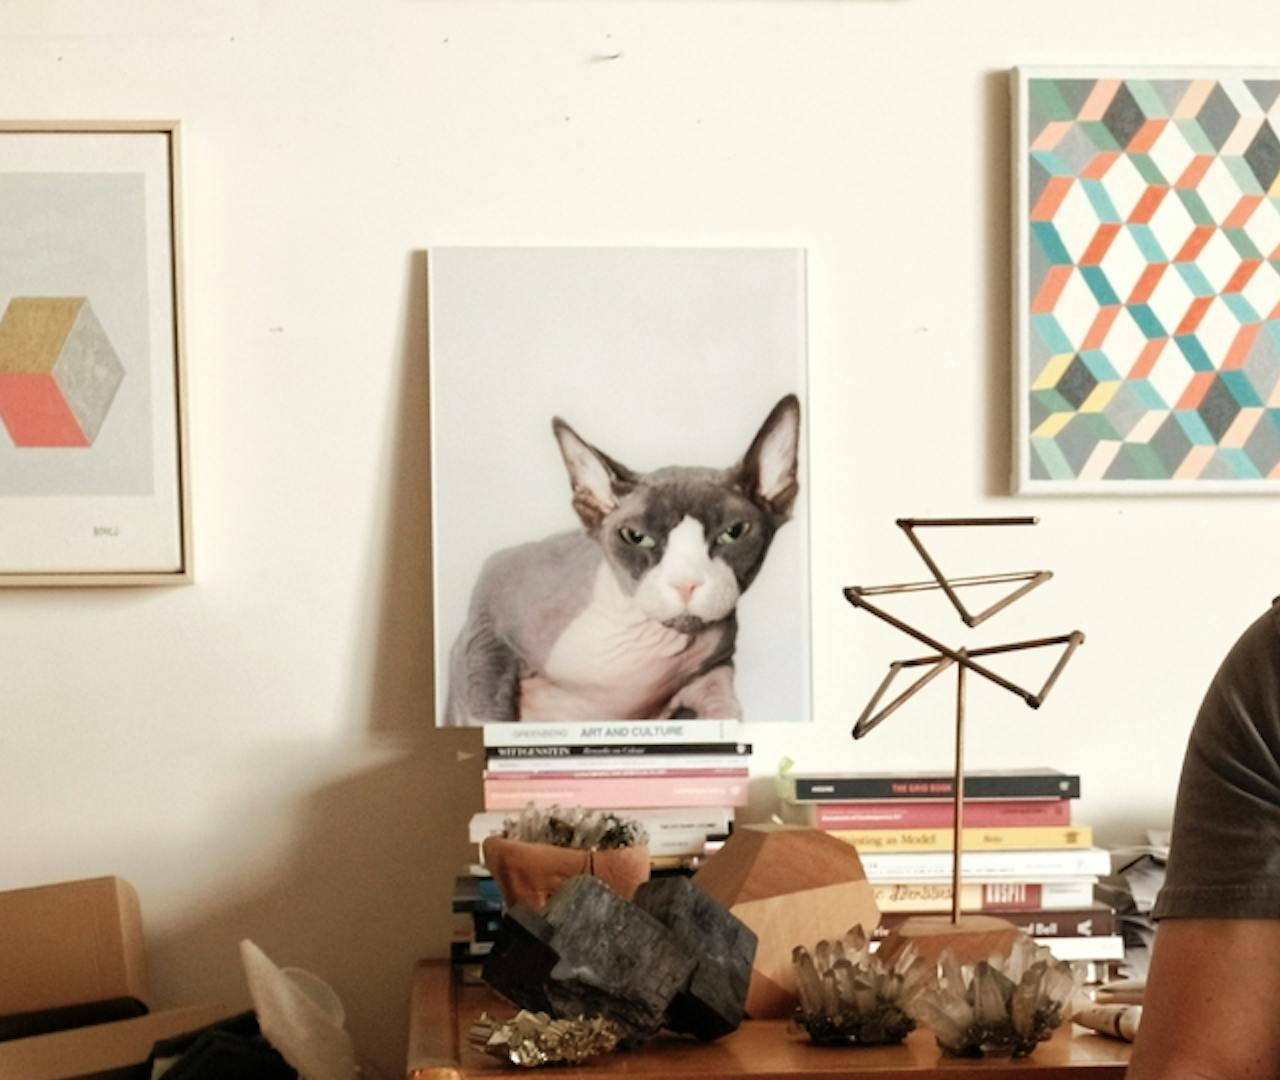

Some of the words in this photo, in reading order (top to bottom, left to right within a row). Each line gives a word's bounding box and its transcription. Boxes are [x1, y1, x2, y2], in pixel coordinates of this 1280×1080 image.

[580, 728, 604, 738] ART
[605, 727, 629, 738] AND
[631, 726, 684, 737] CULTURE
[497, 747, 570, 757] WITTGENSTEIN
[892, 783, 907, 793] THE
[908, 783, 929, 793] GRID
[930, 783, 952, 793] BOOK
[901, 833, 937, 845] Model
[1036, 923, 1057, 935] Bell
